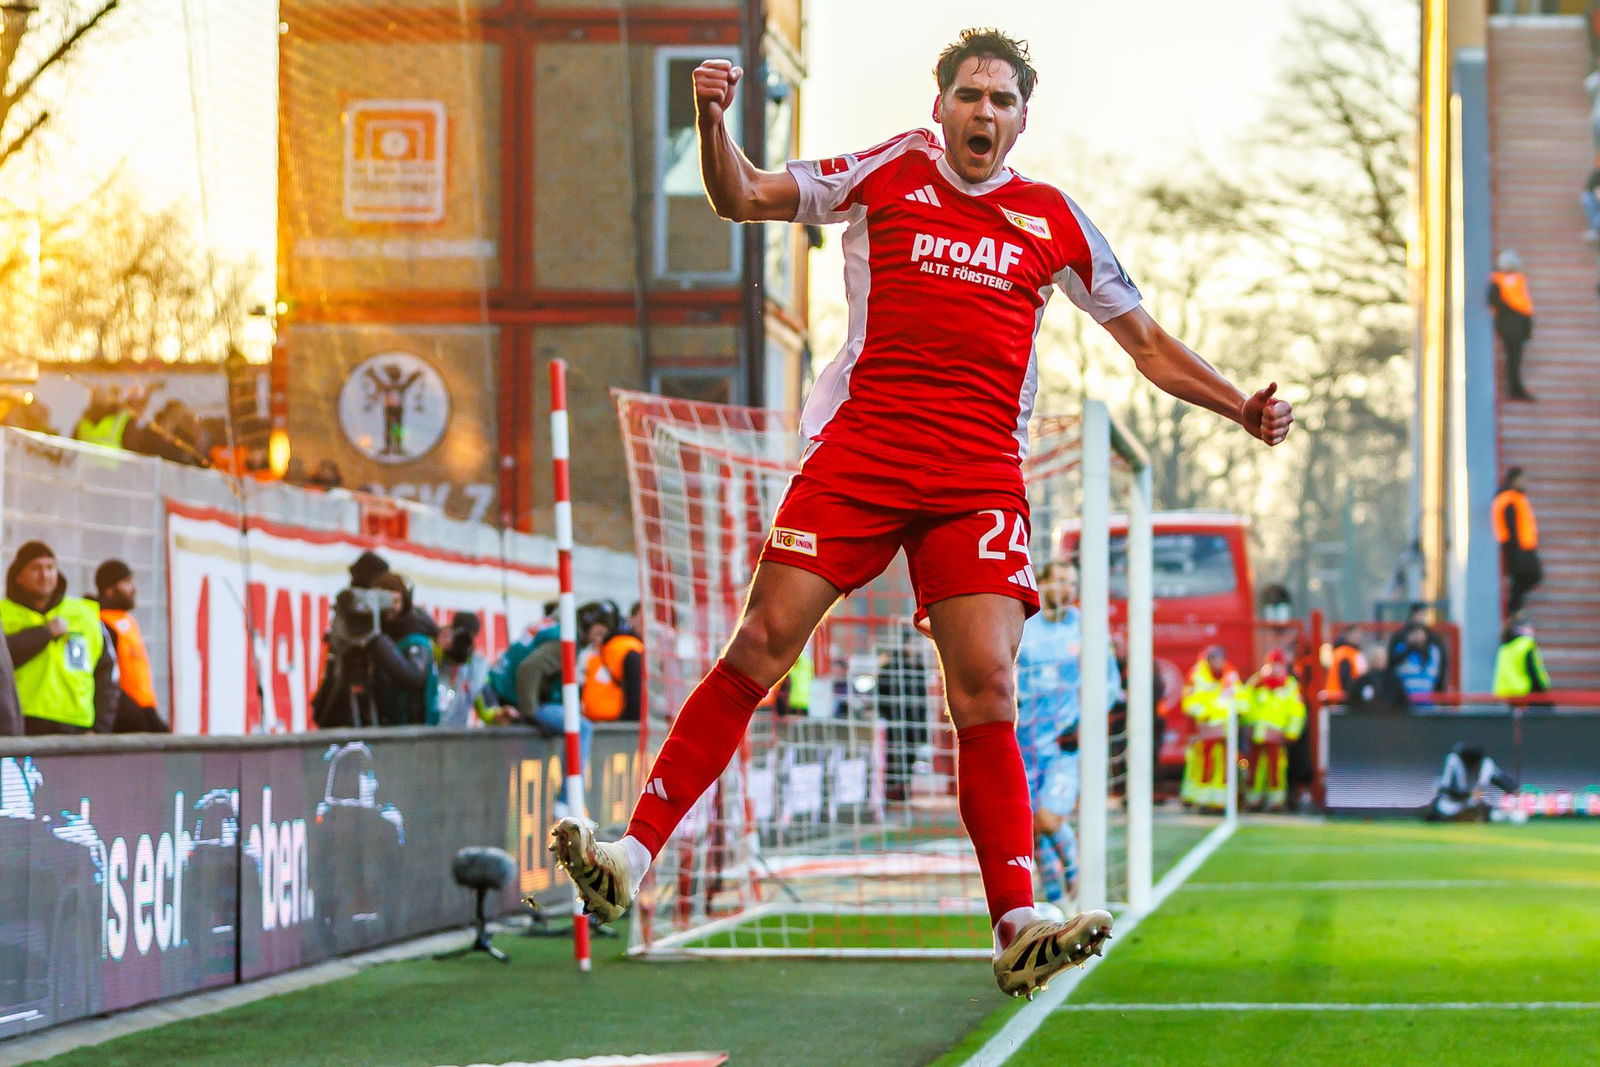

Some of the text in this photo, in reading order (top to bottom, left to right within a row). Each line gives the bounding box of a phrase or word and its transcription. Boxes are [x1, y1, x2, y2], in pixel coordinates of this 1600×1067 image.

[911, 233, 1024, 275] proAF
[920, 261, 1013, 291] ALTE FÖRSTEREI
[977, 509, 1032, 565] 24
